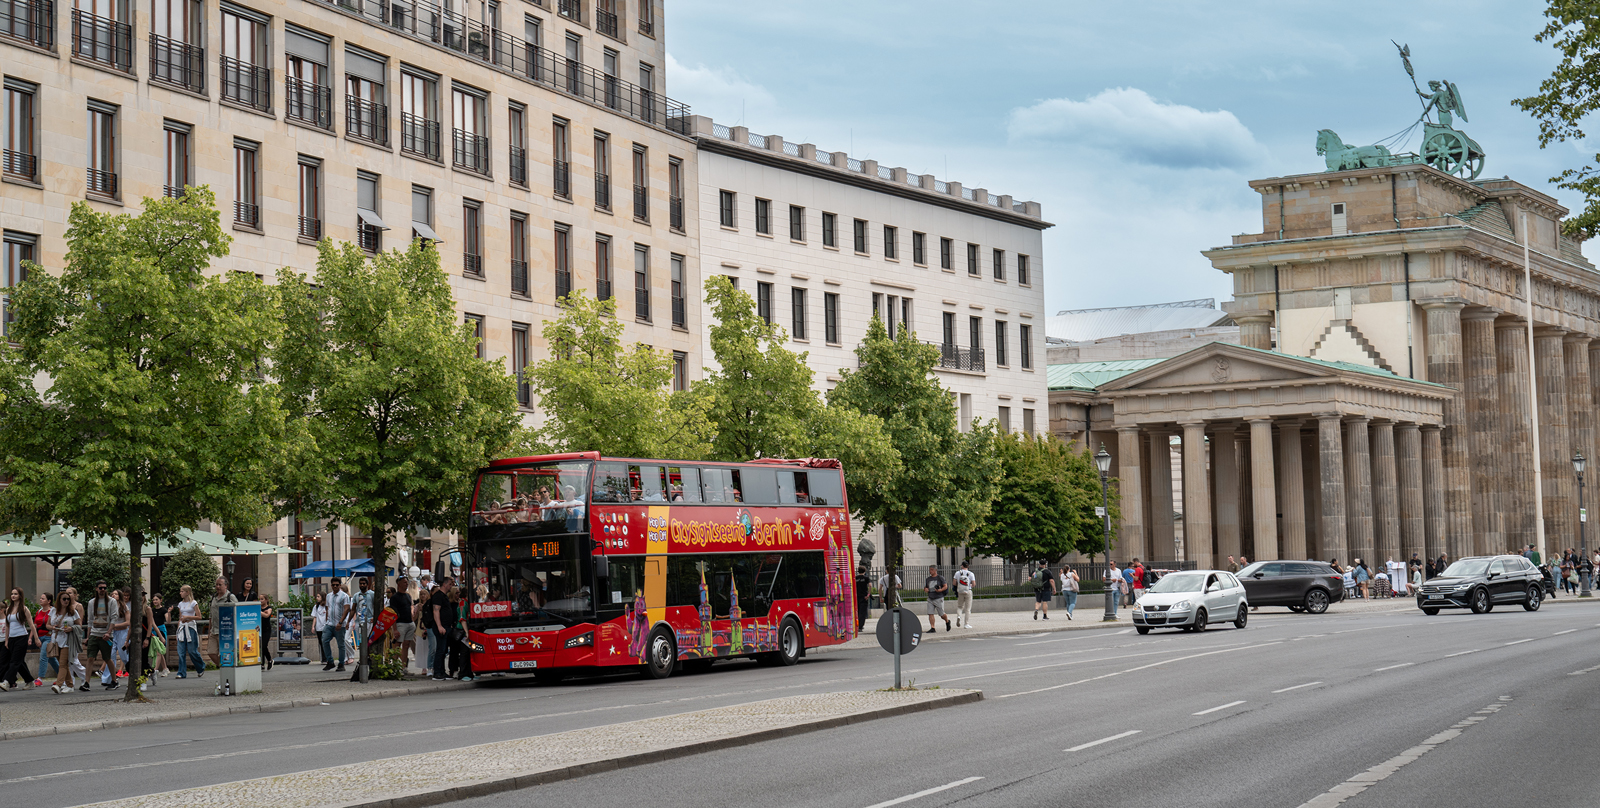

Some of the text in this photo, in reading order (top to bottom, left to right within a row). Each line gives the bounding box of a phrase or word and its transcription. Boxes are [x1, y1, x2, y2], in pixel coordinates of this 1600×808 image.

[648, 516, 667, 529] Hop On
[648, 529, 667, 543] Hop Off
[754, 515, 793, 546] Berlin
